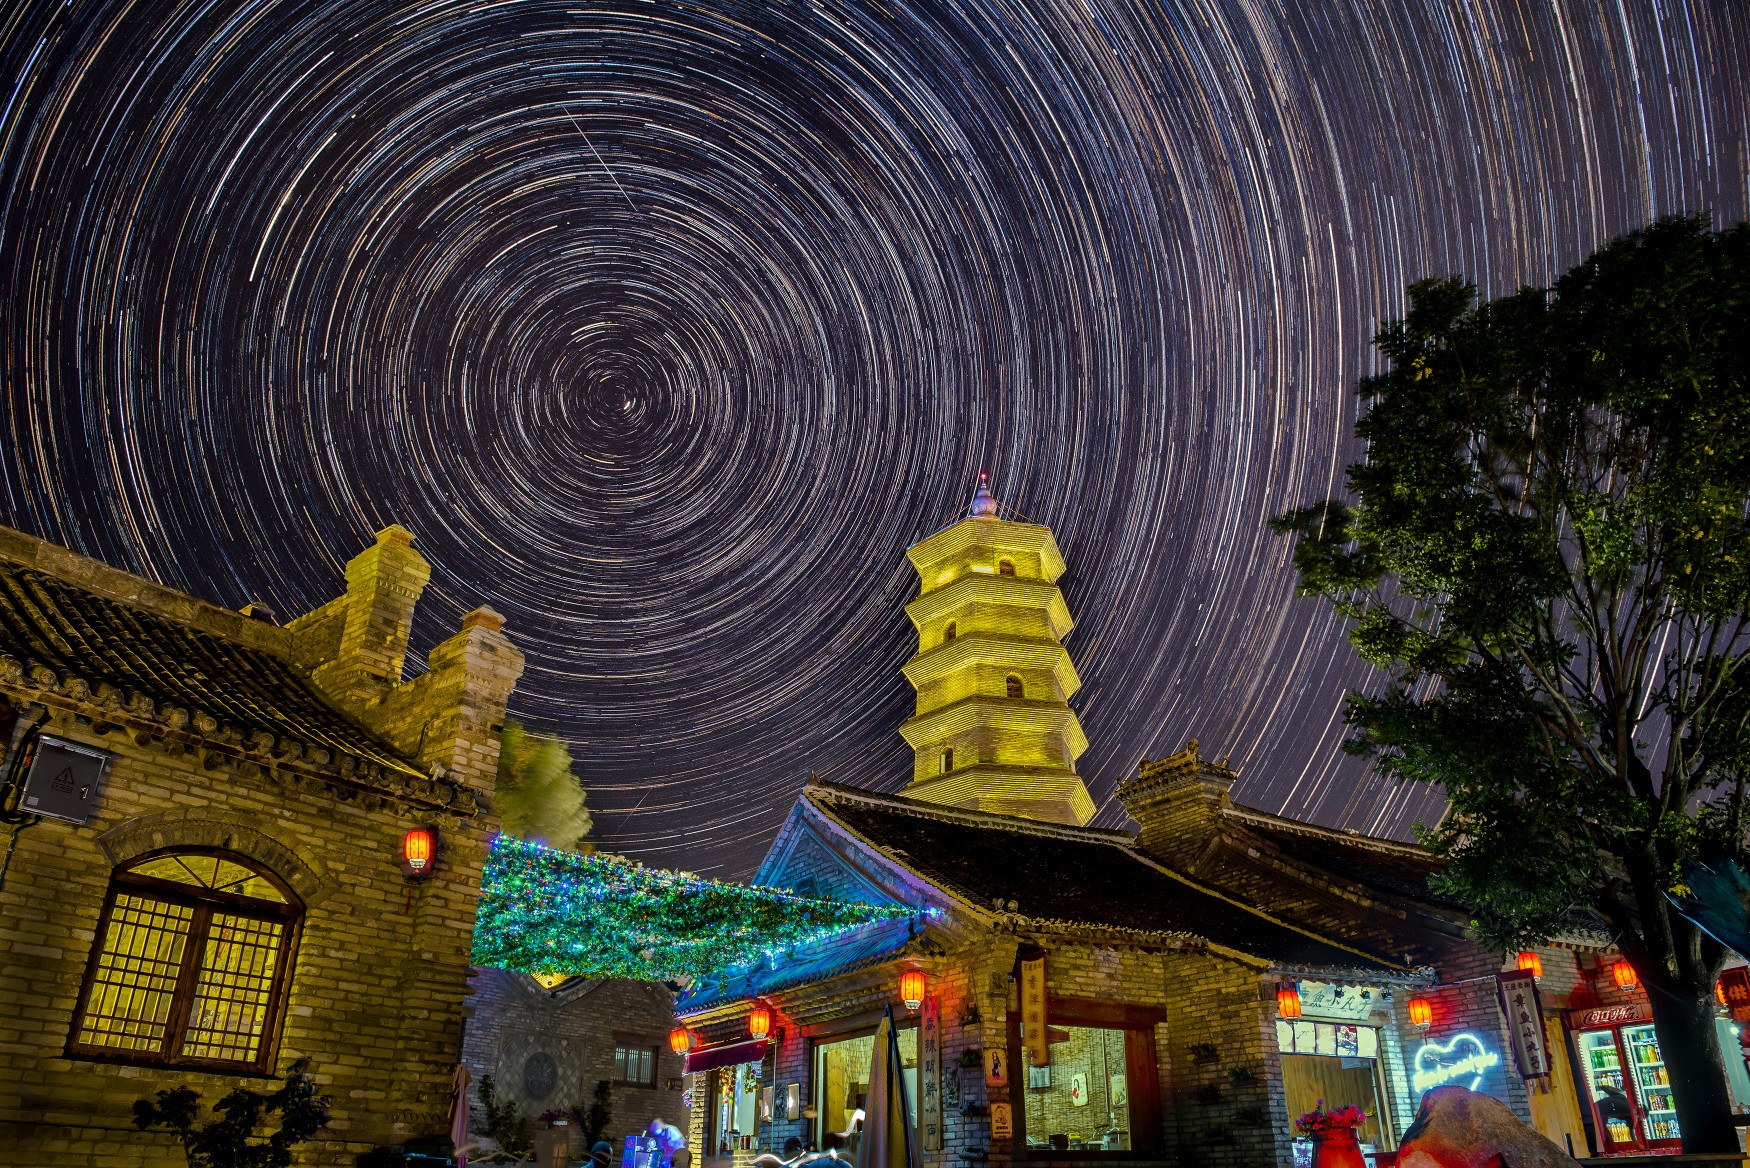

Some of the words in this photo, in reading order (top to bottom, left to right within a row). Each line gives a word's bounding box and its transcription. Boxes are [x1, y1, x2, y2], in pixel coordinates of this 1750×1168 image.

[1512, 993, 1540, 1070] 章鱼小丸子
